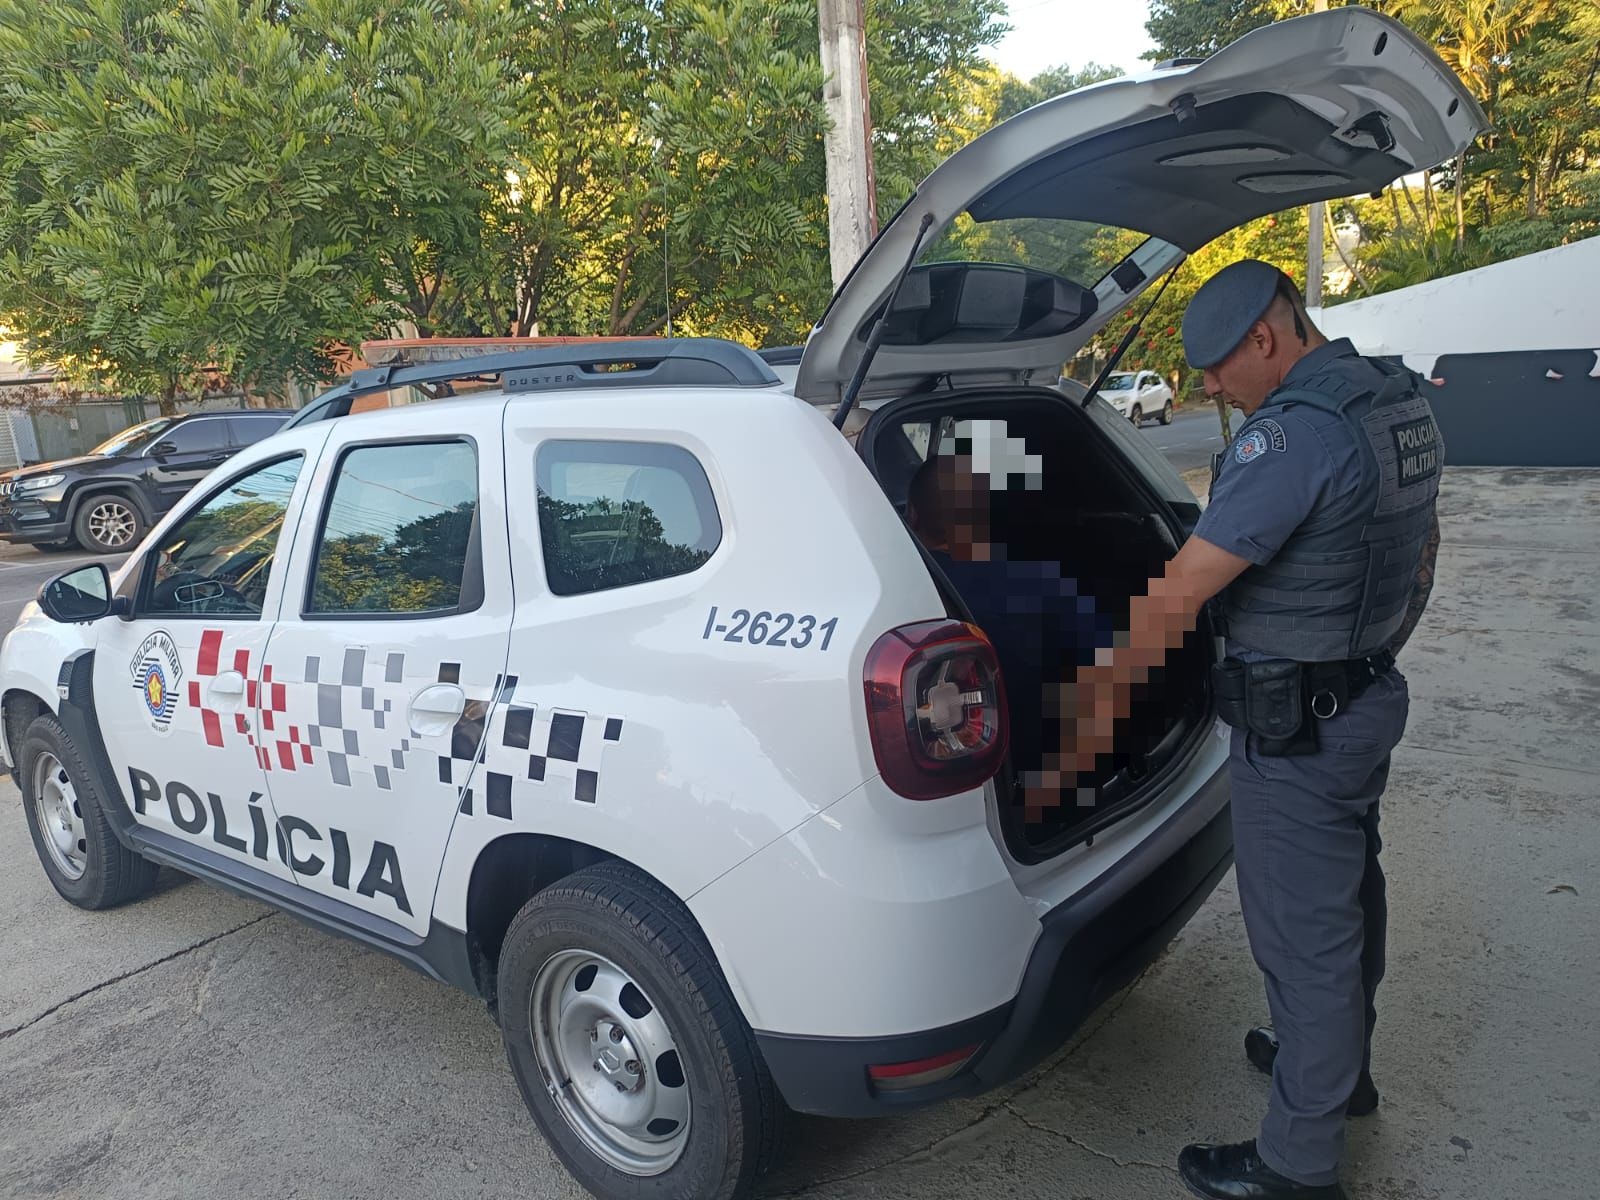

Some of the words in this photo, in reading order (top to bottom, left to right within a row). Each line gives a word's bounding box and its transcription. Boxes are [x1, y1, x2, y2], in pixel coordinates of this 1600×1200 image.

[509, 374, 575, 387] DUSTER
[1397, 423, 1435, 451] POLICIA
[1402, 449, 1436, 479] MILITAR
[702, 606, 839, 651] I-26231
[158, 636, 180, 678] MILITAR
[128, 766, 415, 917] POLÍCIA
